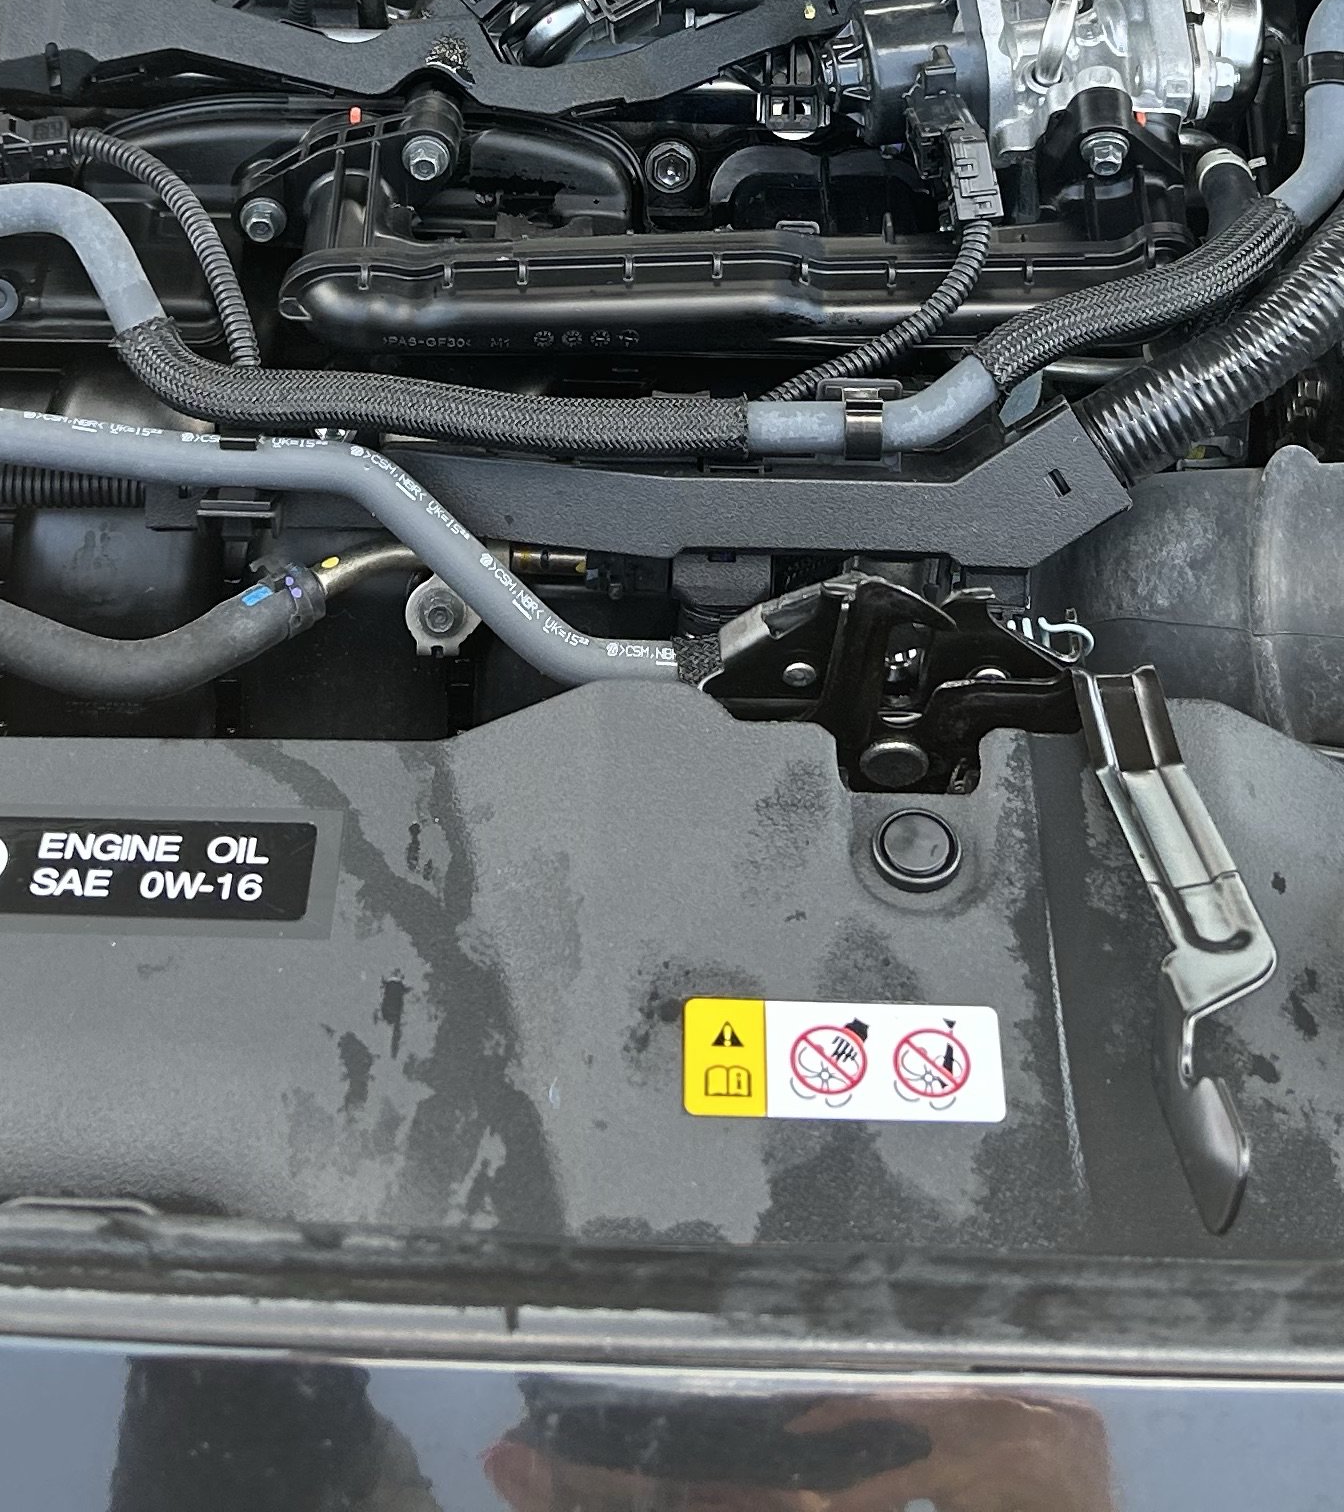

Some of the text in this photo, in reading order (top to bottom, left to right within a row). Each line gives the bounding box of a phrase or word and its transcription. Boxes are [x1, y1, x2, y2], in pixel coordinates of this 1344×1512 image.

[37, 831, 270, 865] ENGINE OIL
[28, 867, 264, 902] SAE 0W-16
